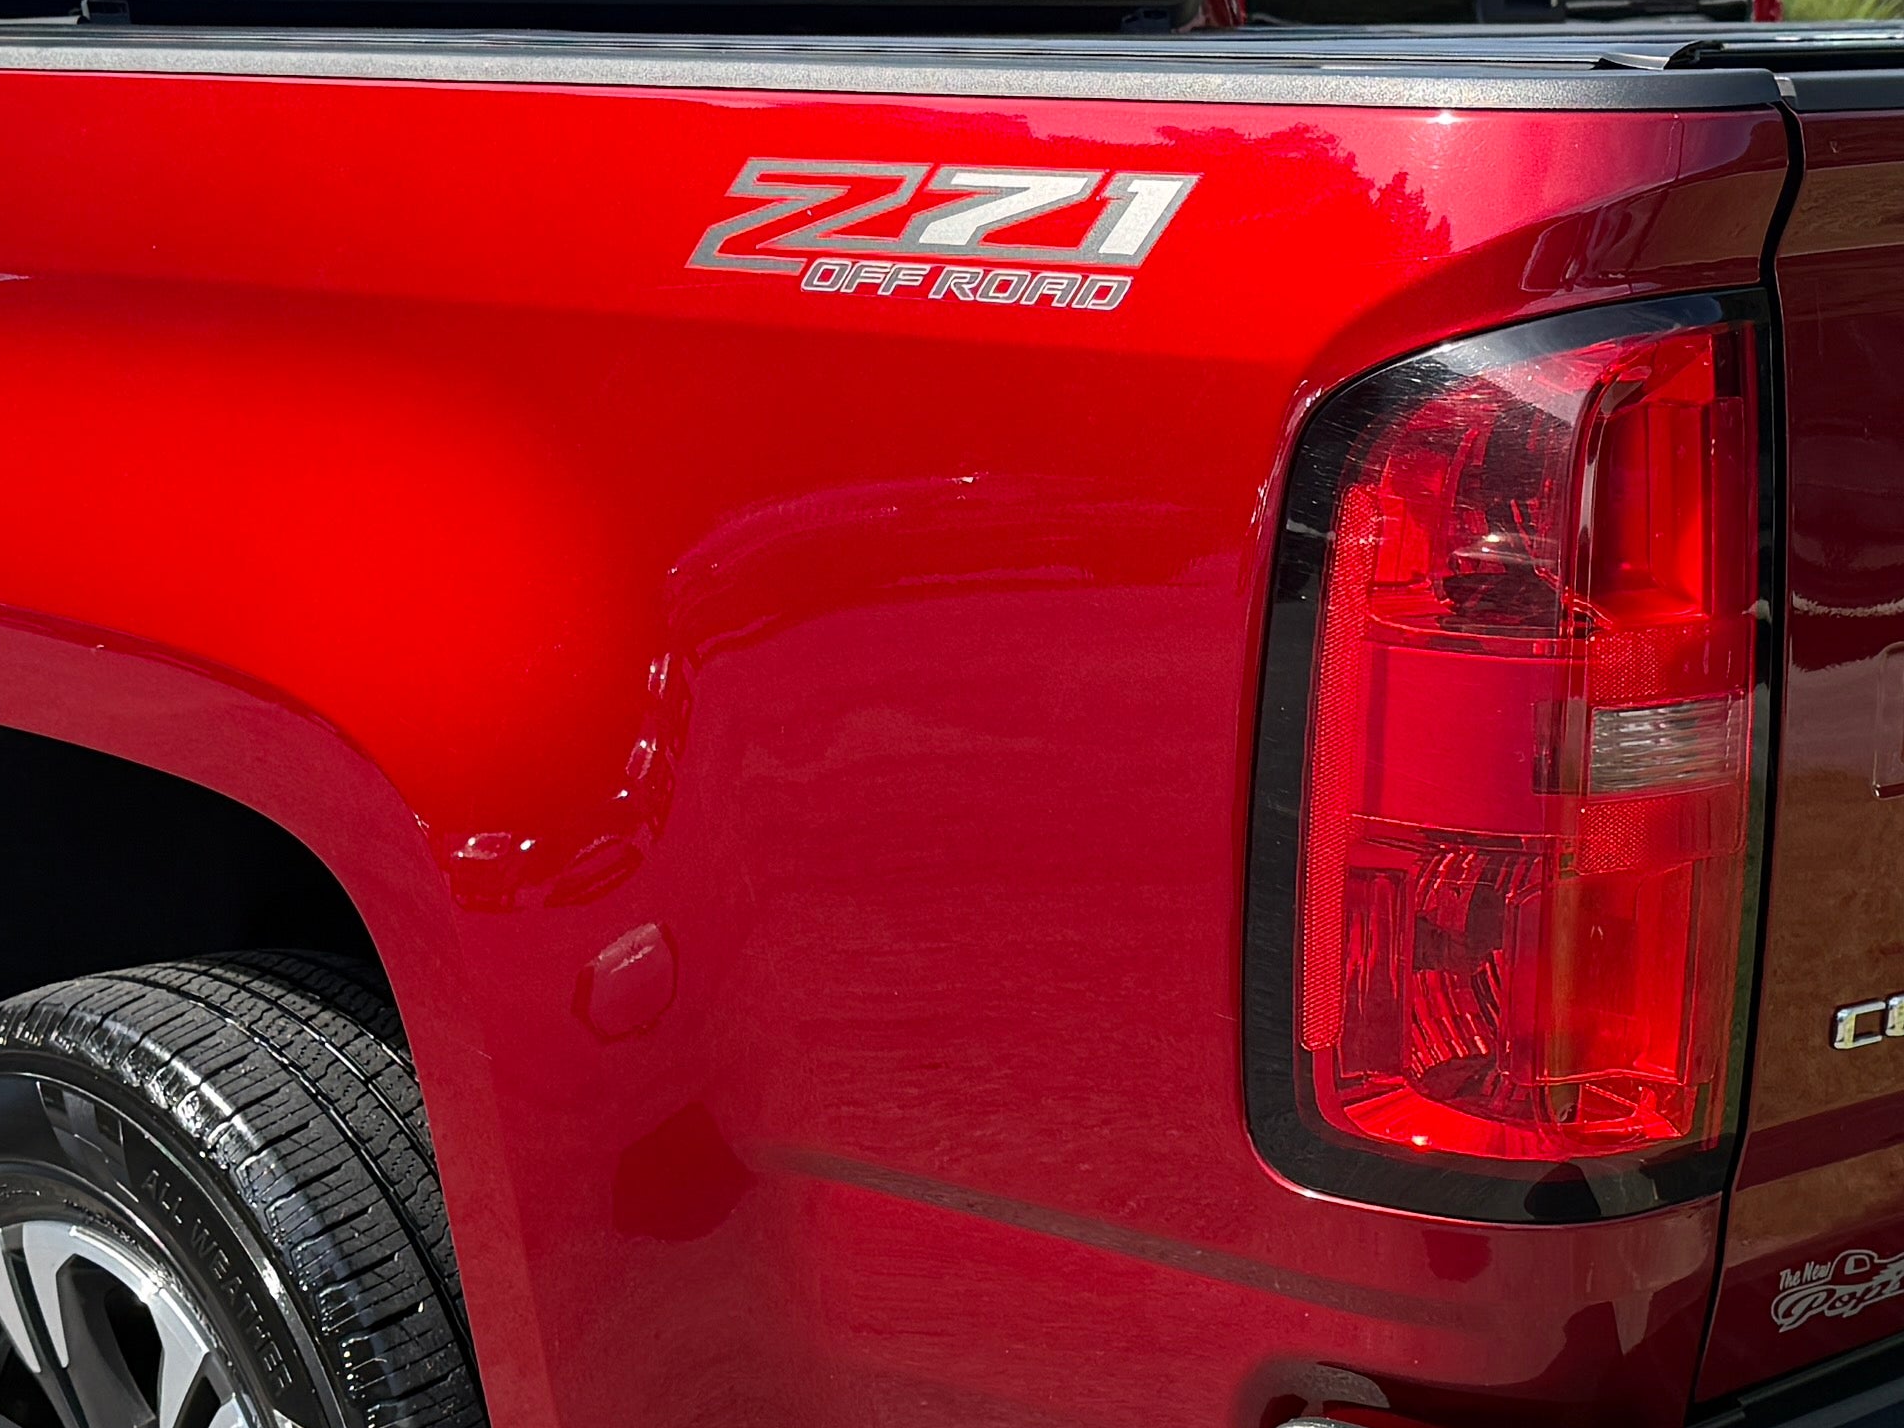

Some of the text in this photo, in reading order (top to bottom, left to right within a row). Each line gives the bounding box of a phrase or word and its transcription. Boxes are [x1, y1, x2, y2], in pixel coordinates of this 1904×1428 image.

[683, 156, 1204, 275] Z71
[800, 258, 1134, 312] OFF ROAD
[144, 1168, 294, 1398] ALL WEATHER
[1779, 1261, 1832, 1292] The New
